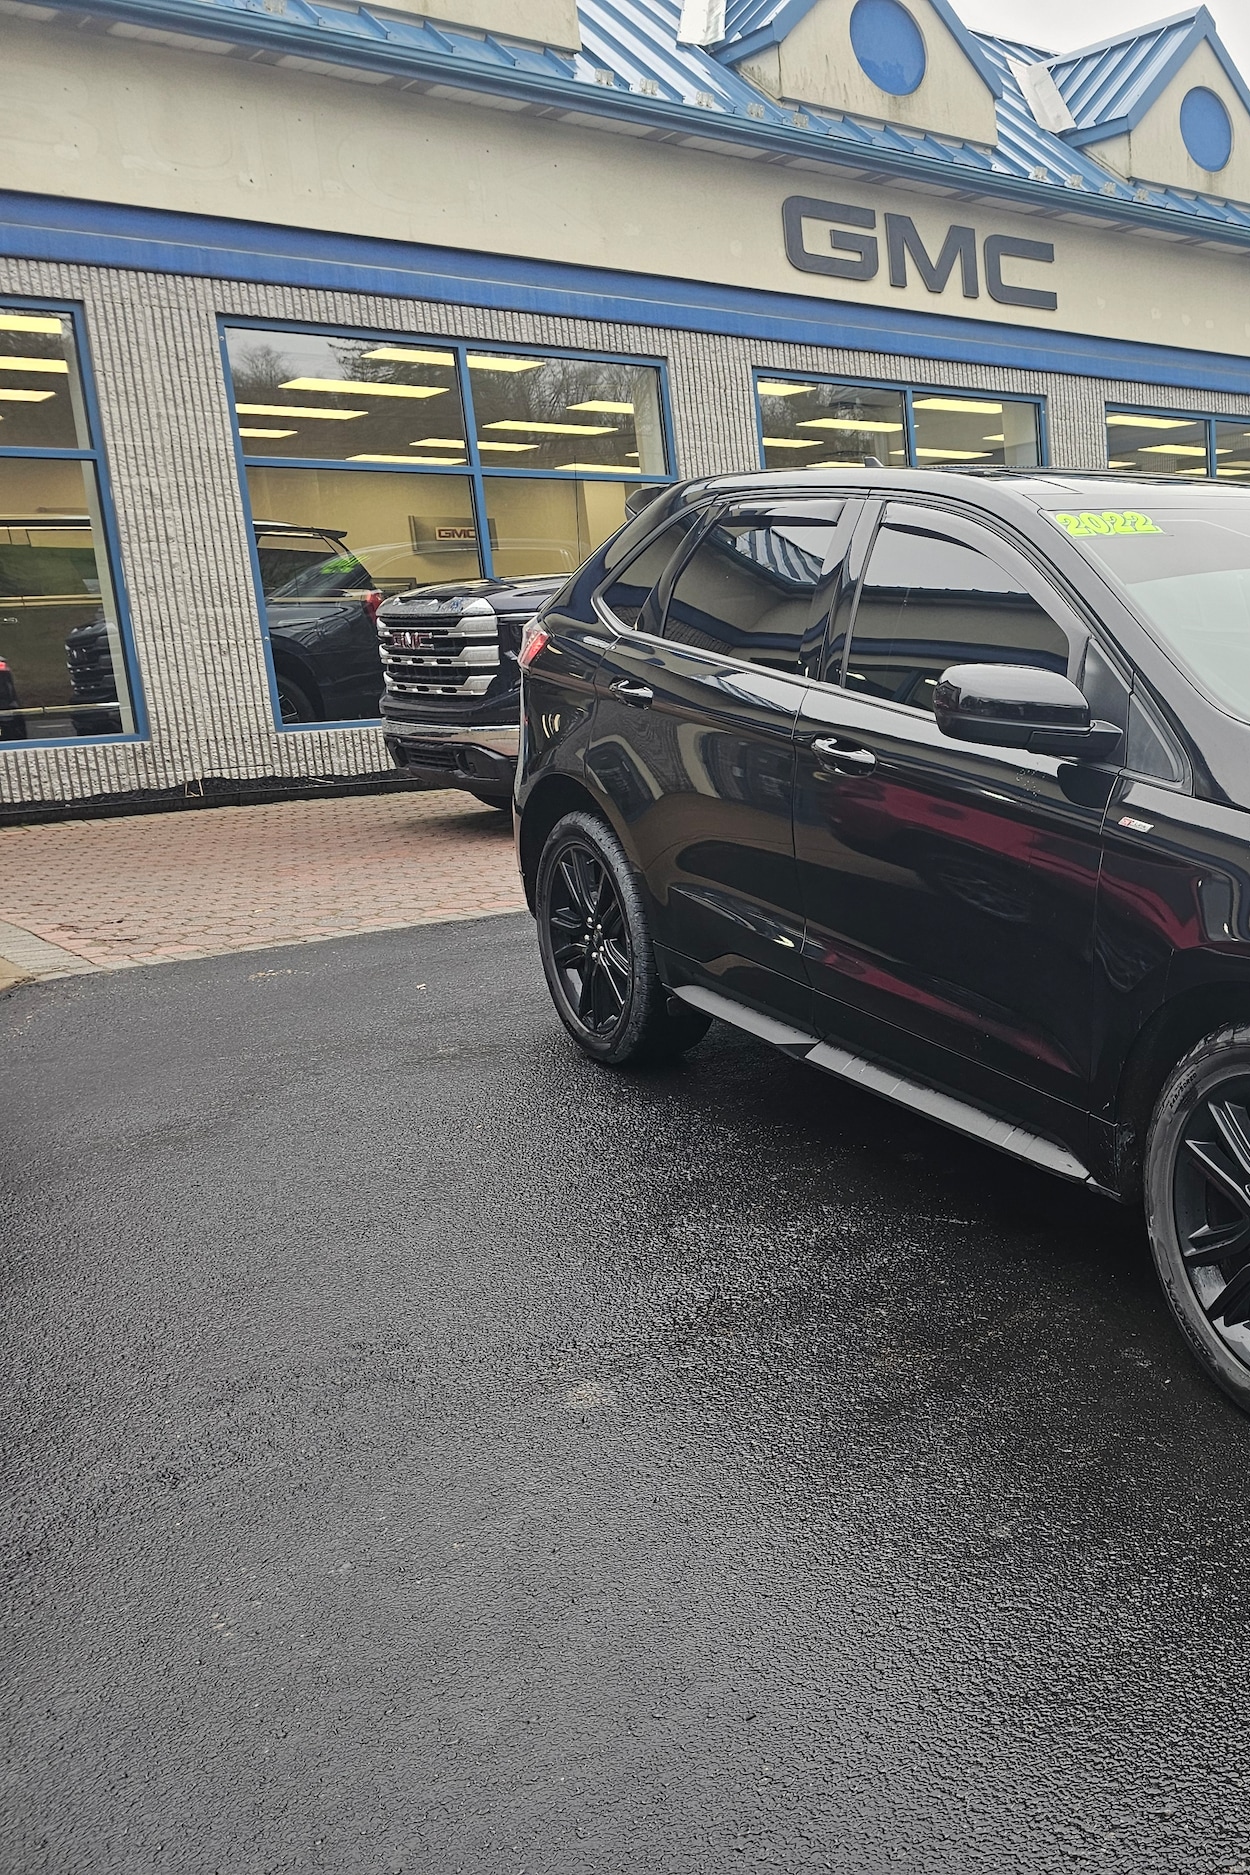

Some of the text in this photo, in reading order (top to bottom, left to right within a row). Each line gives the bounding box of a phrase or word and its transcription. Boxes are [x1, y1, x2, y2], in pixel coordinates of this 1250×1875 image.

[782, 195, 1057, 310] GMC
[438, 529, 476, 538] GMC
[1055, 511, 1163, 537] 2022
[394, 630, 434, 648] GMC
